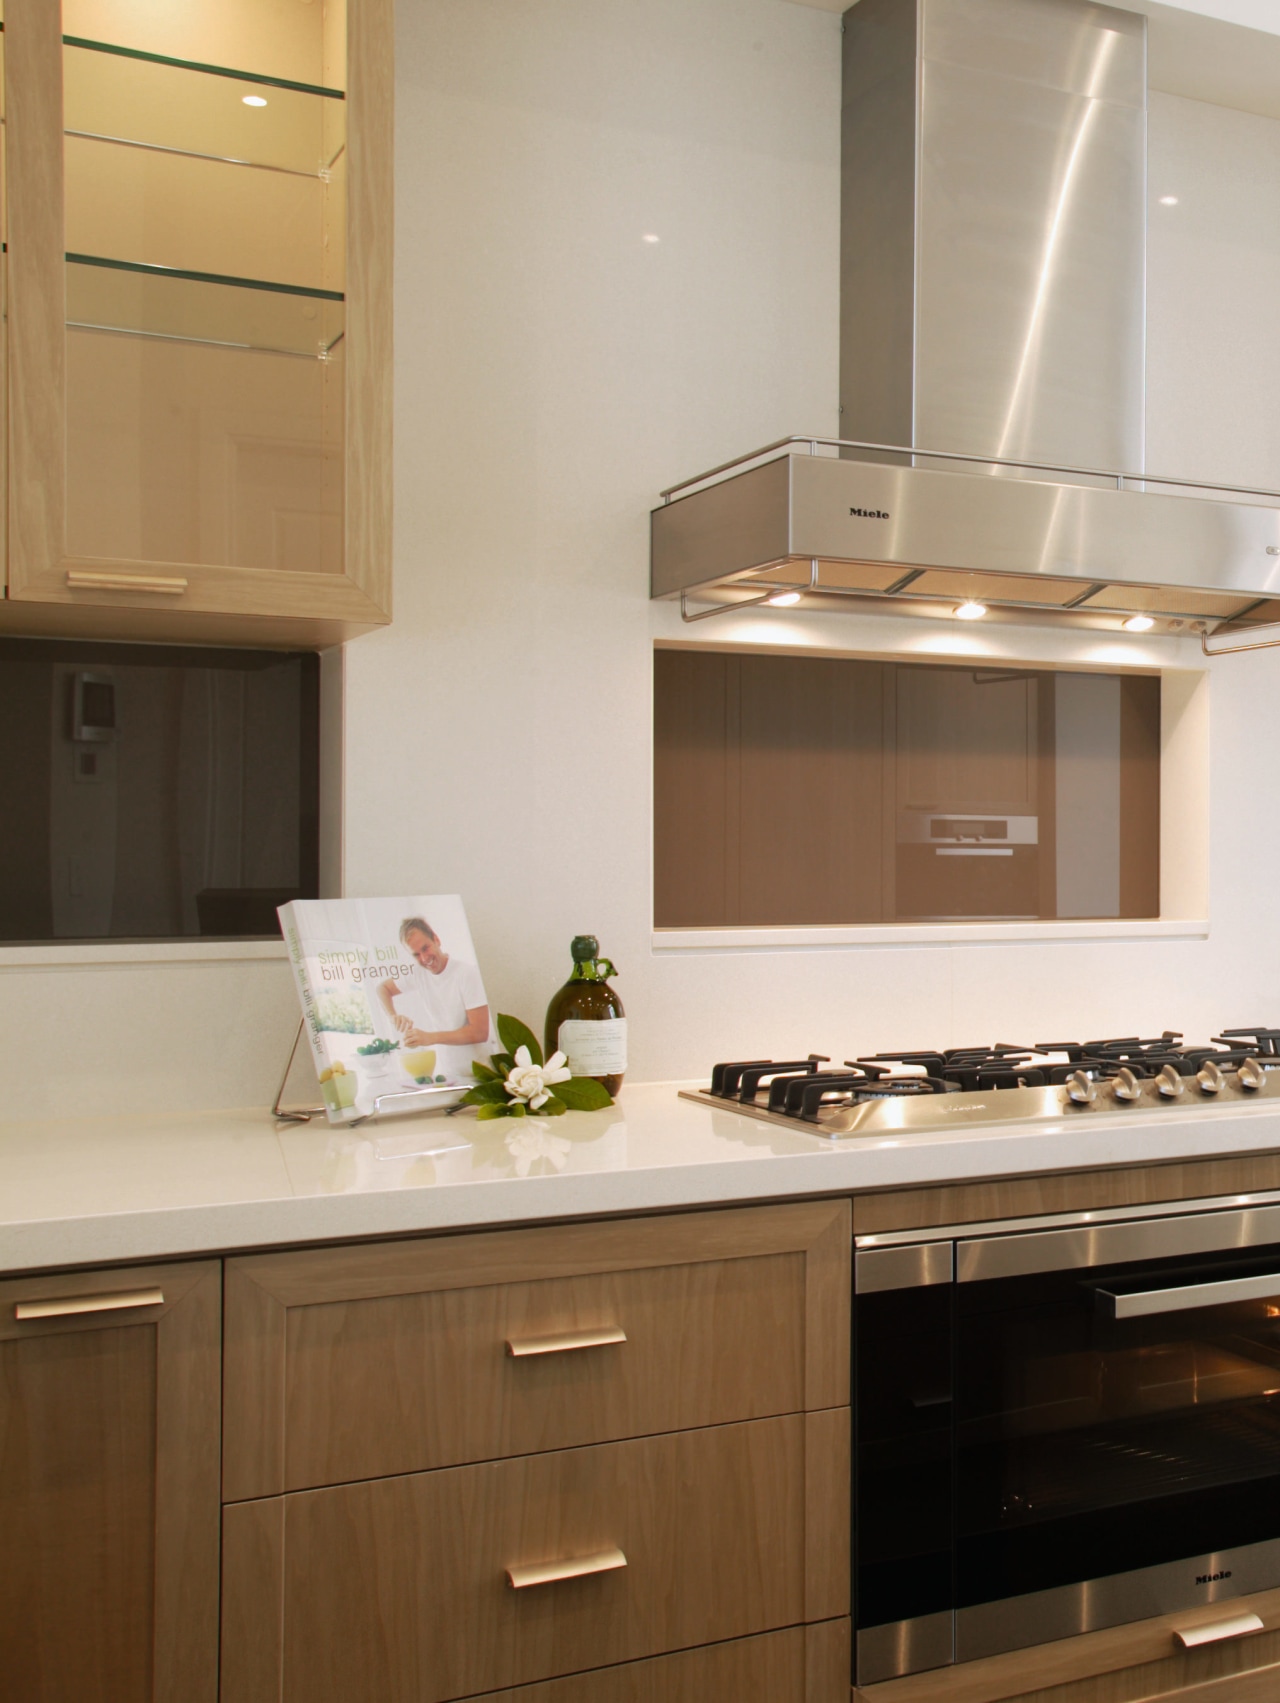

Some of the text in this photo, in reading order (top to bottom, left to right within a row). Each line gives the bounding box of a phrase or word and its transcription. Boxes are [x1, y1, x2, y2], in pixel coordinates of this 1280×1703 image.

[849, 507, 890, 520] Miele
[318, 945, 398, 967] simply bill
[321, 963, 414, 983] bill granger
[288, 927, 324, 1054] simply bill bill granger
[1195, 1571, 1232, 1586] Miele
